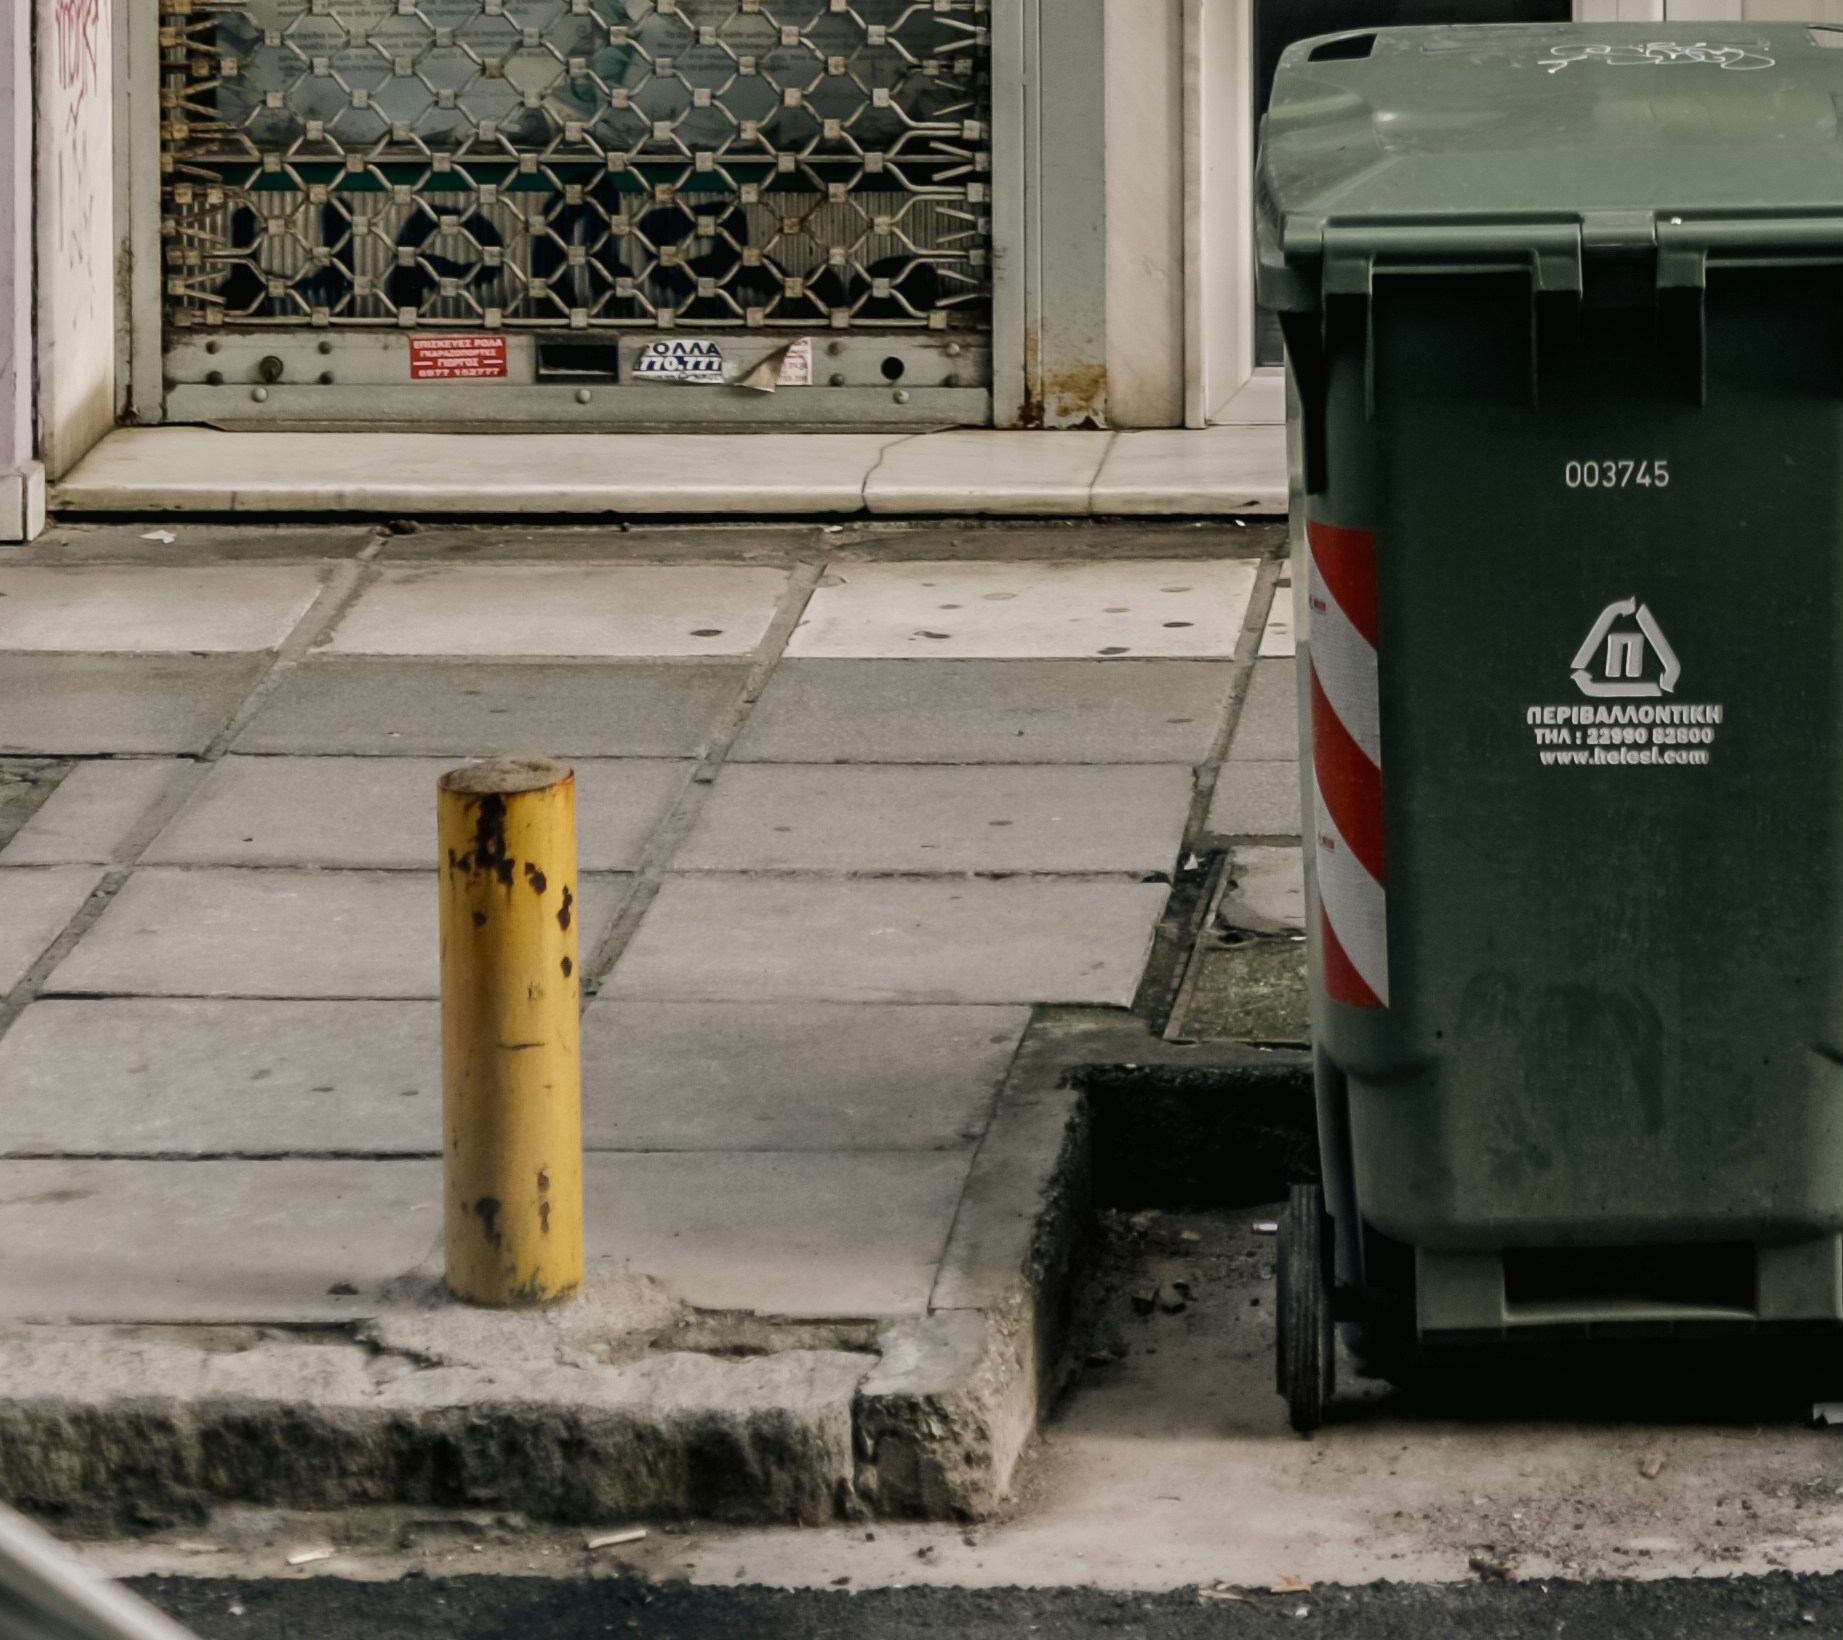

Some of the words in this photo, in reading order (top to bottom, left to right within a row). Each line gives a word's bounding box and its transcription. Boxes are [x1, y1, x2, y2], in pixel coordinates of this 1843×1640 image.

[646, 342, 721, 356] ΟΛΛΑ
[1565, 460, 1670, 488] 003745
[1526, 704, 1724, 725] ΠΕΡΙΒΑΛΛΟΝΤΙΚΗ
[1586, 727, 1648, 745] 22990
